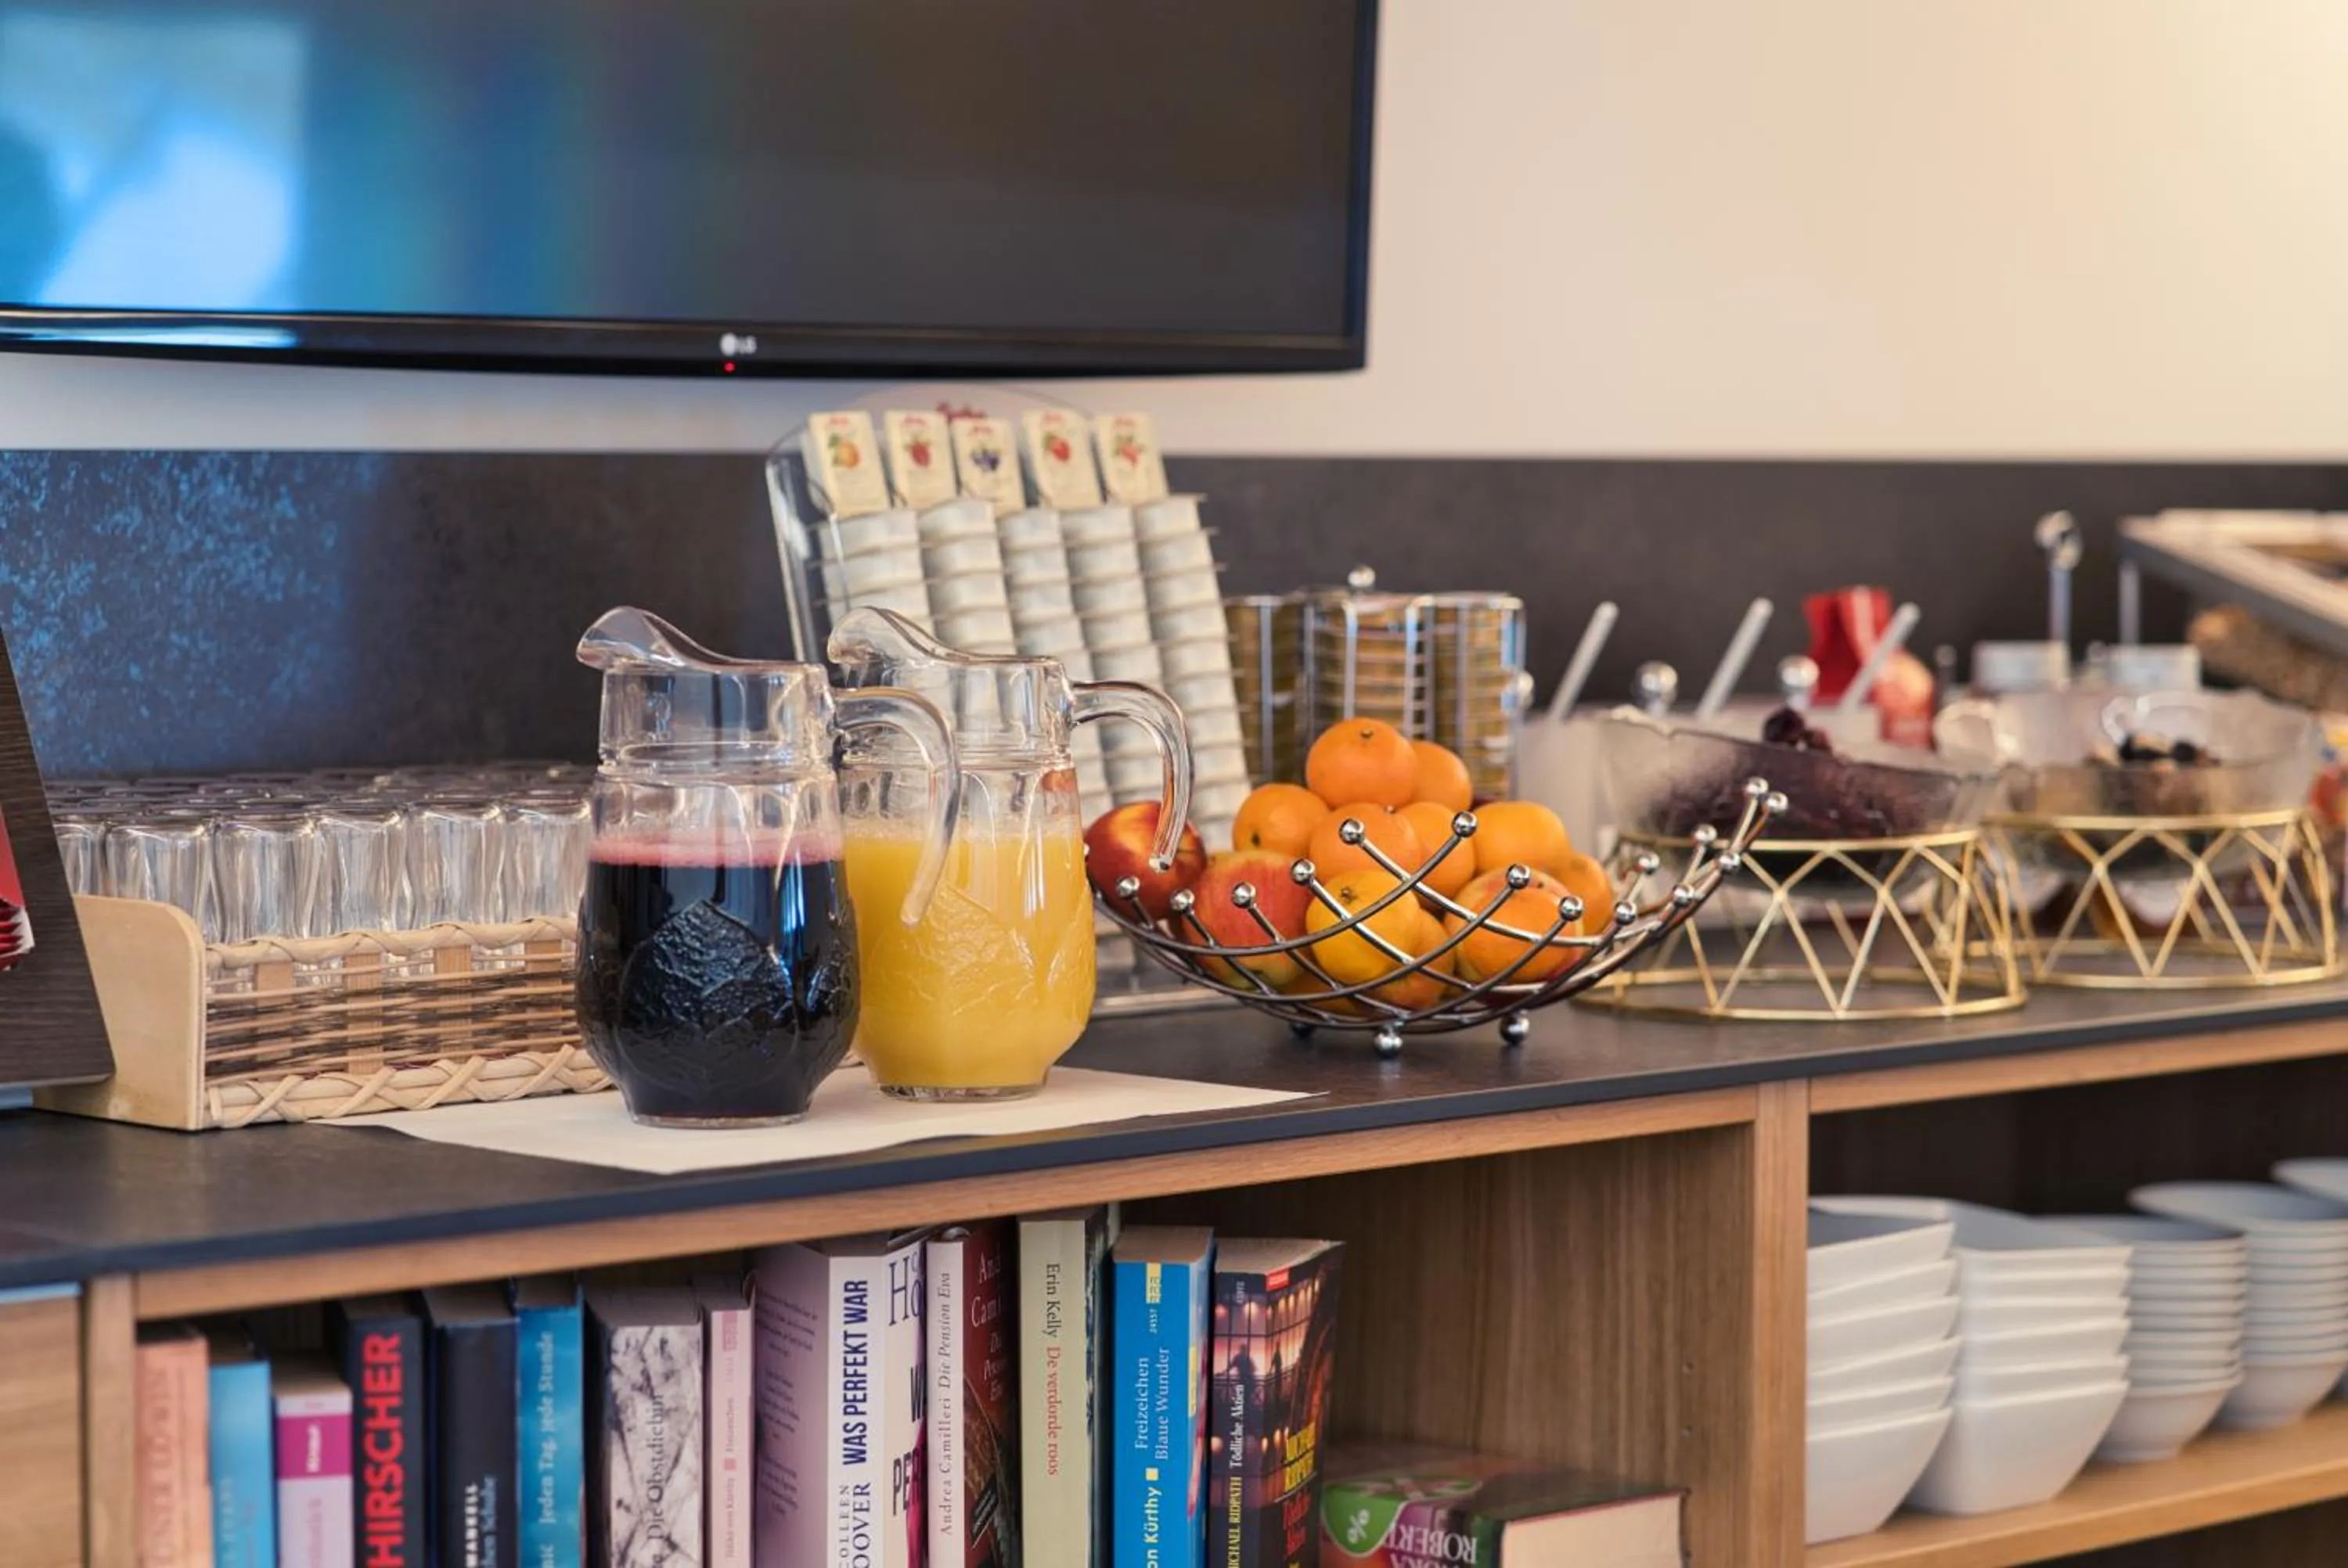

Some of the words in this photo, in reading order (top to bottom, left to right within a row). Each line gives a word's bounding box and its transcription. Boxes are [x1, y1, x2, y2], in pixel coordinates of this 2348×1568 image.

[842, 1279, 869, 1325] WAR
[938, 1271, 952, 1299] Eva
[1046, 1262, 1061, 1296] Erin
[938, 1304, 953, 1358] Pension
[1042, 1300, 1061, 1338] Kelly
[538, 1331, 555, 1393] Stunde
[842, 1329, 869, 1417] PERFEKT
[938, 1361, 953, 1390] Die
[1046, 1346, 1061, 1368] De
[1154, 1347, 1169, 1412] Wunder
[538, 1397, 556, 1432] jede
[1046, 1372, 1063, 1440] verdorde
[1135, 1358, 1149, 1450] Freizeichen
[1230, 1384, 1245, 1419] Aktien
[361, 1332, 405, 1568] HIRSCHER
[645, 1394, 665, 1504] Obstdiebin
[842, 1421, 868, 1466] WAS
[938, 1397, 952, 1474] Camilleri
[1155, 1416, 1169, 1461] Blaue
[1230, 1422, 1244, 1469] Tödliche
[1046, 1443, 1059, 1476] roos
[538, 1476, 556, 1525] Jeden
[938, 1479, 953, 1536] Andrea
[1143, 1486, 1162, 1544] Kürthy
[1229, 1476, 1243, 1524] RIDPATH
[646, 1507, 665, 1541] Die
[851, 1482, 871, 1568] OOVER
[1388, 1524, 1479, 1565] ROBERT
[1146, 1548, 1159, 1568] on
